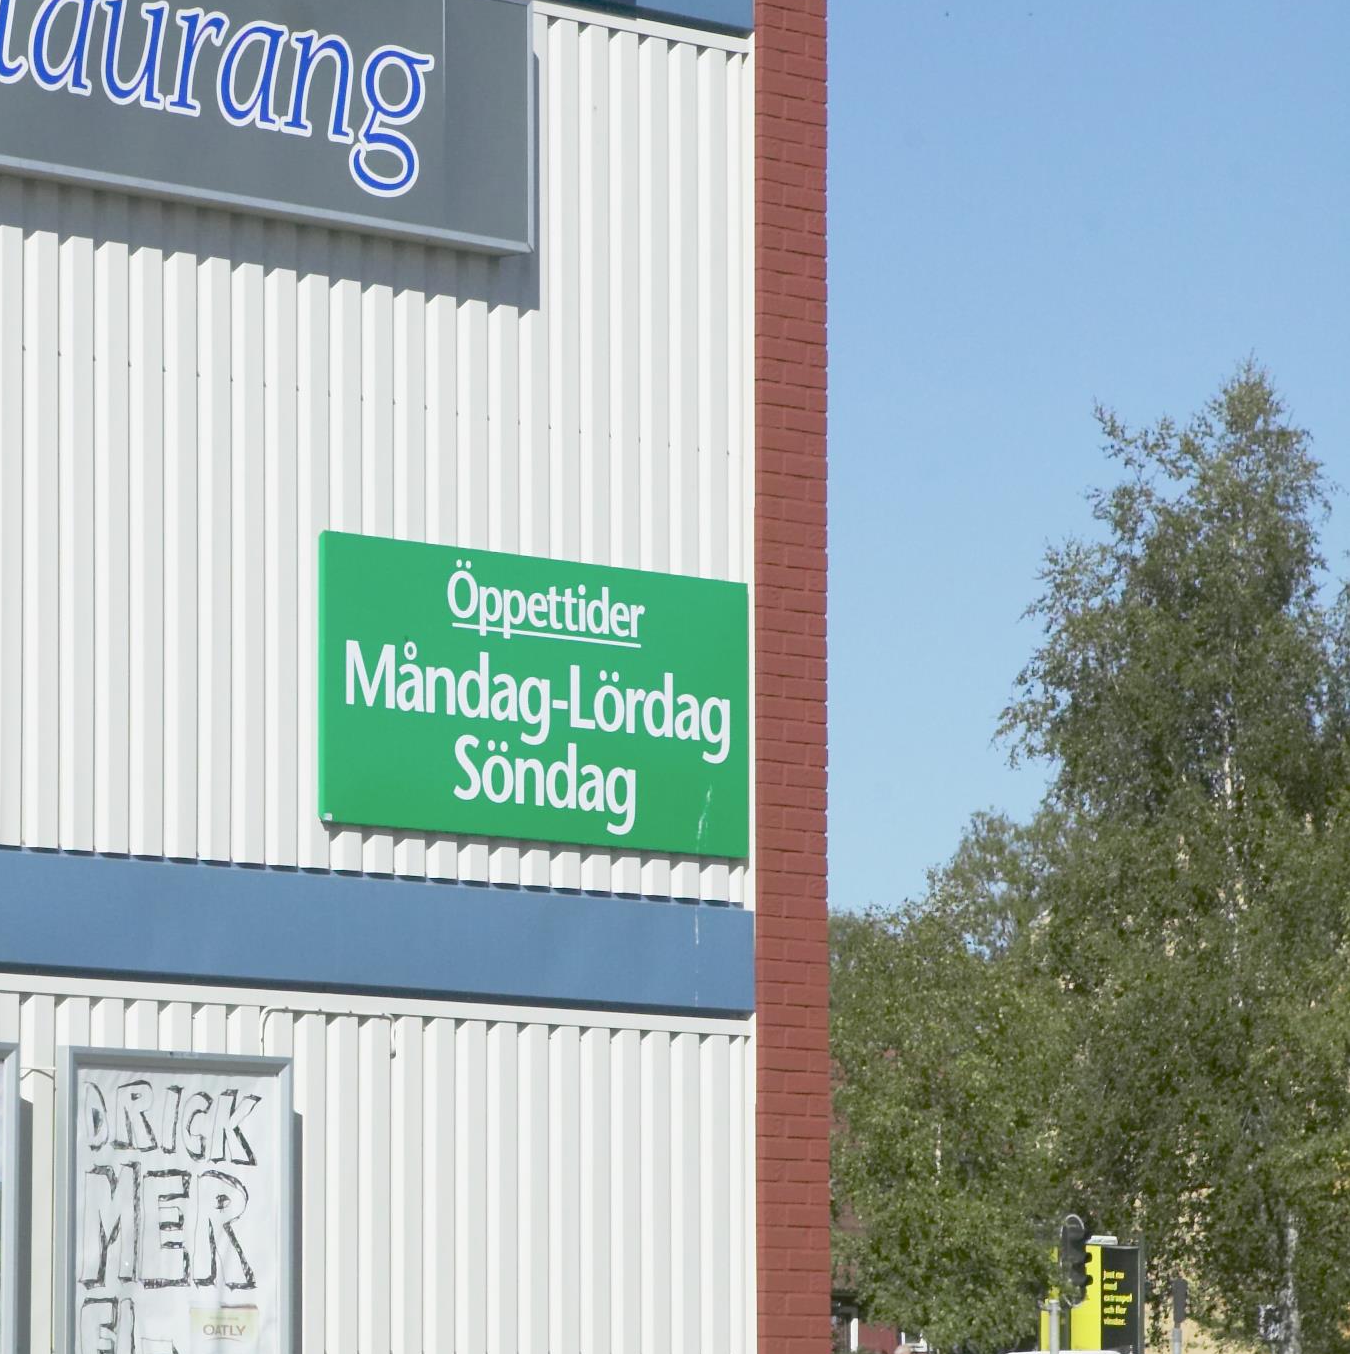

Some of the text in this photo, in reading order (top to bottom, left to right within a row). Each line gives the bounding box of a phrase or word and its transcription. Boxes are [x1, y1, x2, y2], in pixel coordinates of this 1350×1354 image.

[447, 559, 646, 639] Öppettider
[344, 638, 732, 765] Måndag-Lördag
[453, 733, 637, 836] Söndag
[82, 1080, 263, 1166] DRICK
[78, 1160, 257, 1290] MER
[202, 1324, 247, 1337] OATLY
